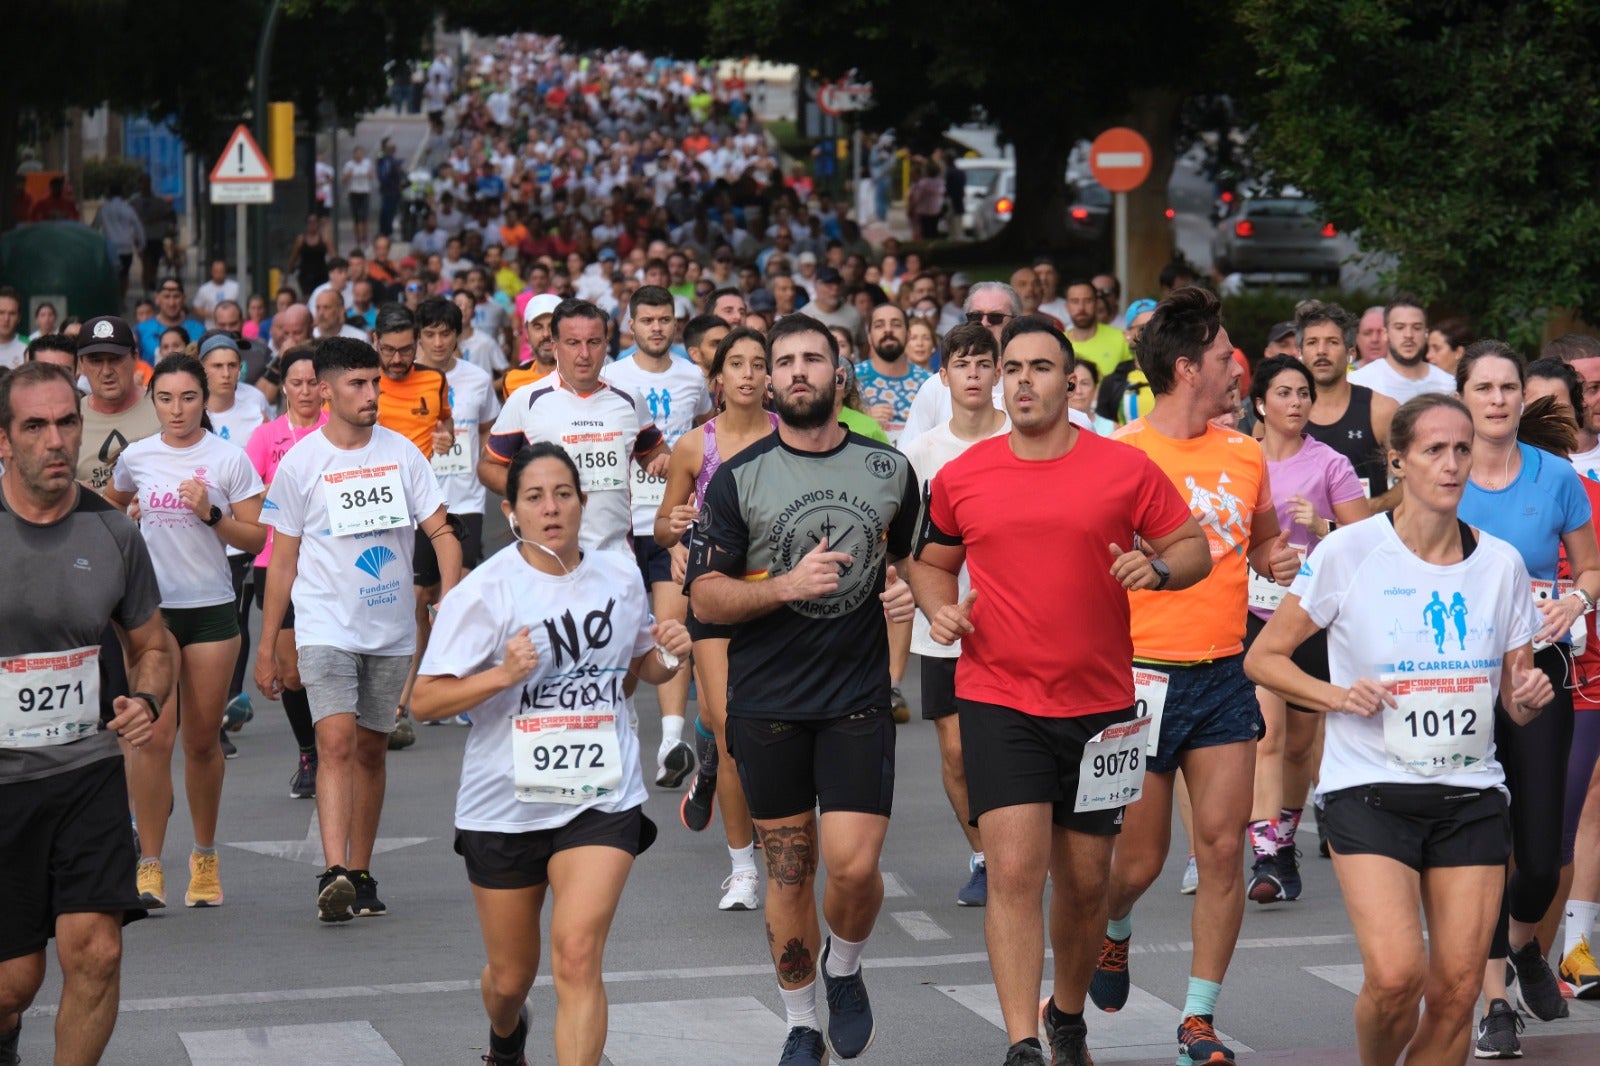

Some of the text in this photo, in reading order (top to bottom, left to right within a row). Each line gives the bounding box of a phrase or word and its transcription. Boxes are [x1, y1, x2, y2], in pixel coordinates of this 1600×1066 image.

[575, 451, 617, 468] 1586
[323, 472, 343, 484] 42
[340, 485, 393, 510] 3845
[769, 489, 834, 551] LEGIONARIOS
[839, 491, 848, 503] A
[359, 580, 400, 596] Fundación
[367, 593, 397, 607] Unicaja
[844, 601, 854, 612] A
[1, 658, 27, 673] 42
[27, 655, 68, 667] CARRERA
[567, 662, 602, 680] se
[1397, 660, 1415, 672] 42
[1417, 660, 1470, 671] CARRERA
[1411, 678, 1454, 687] CARRERA
[1456, 676, 1489, 686] URBANA
[1437, 685, 1474, 693] MALAGA
[18, 680, 84, 712] 9271
[515, 718, 541, 733] 42
[541, 716, 581, 725] CARRERA
[566, 722, 598, 730] MALAGA
[1404, 709, 1477, 738] 1012
[533, 744, 605, 771] 9272
[1093, 747, 1139, 778] 9078
